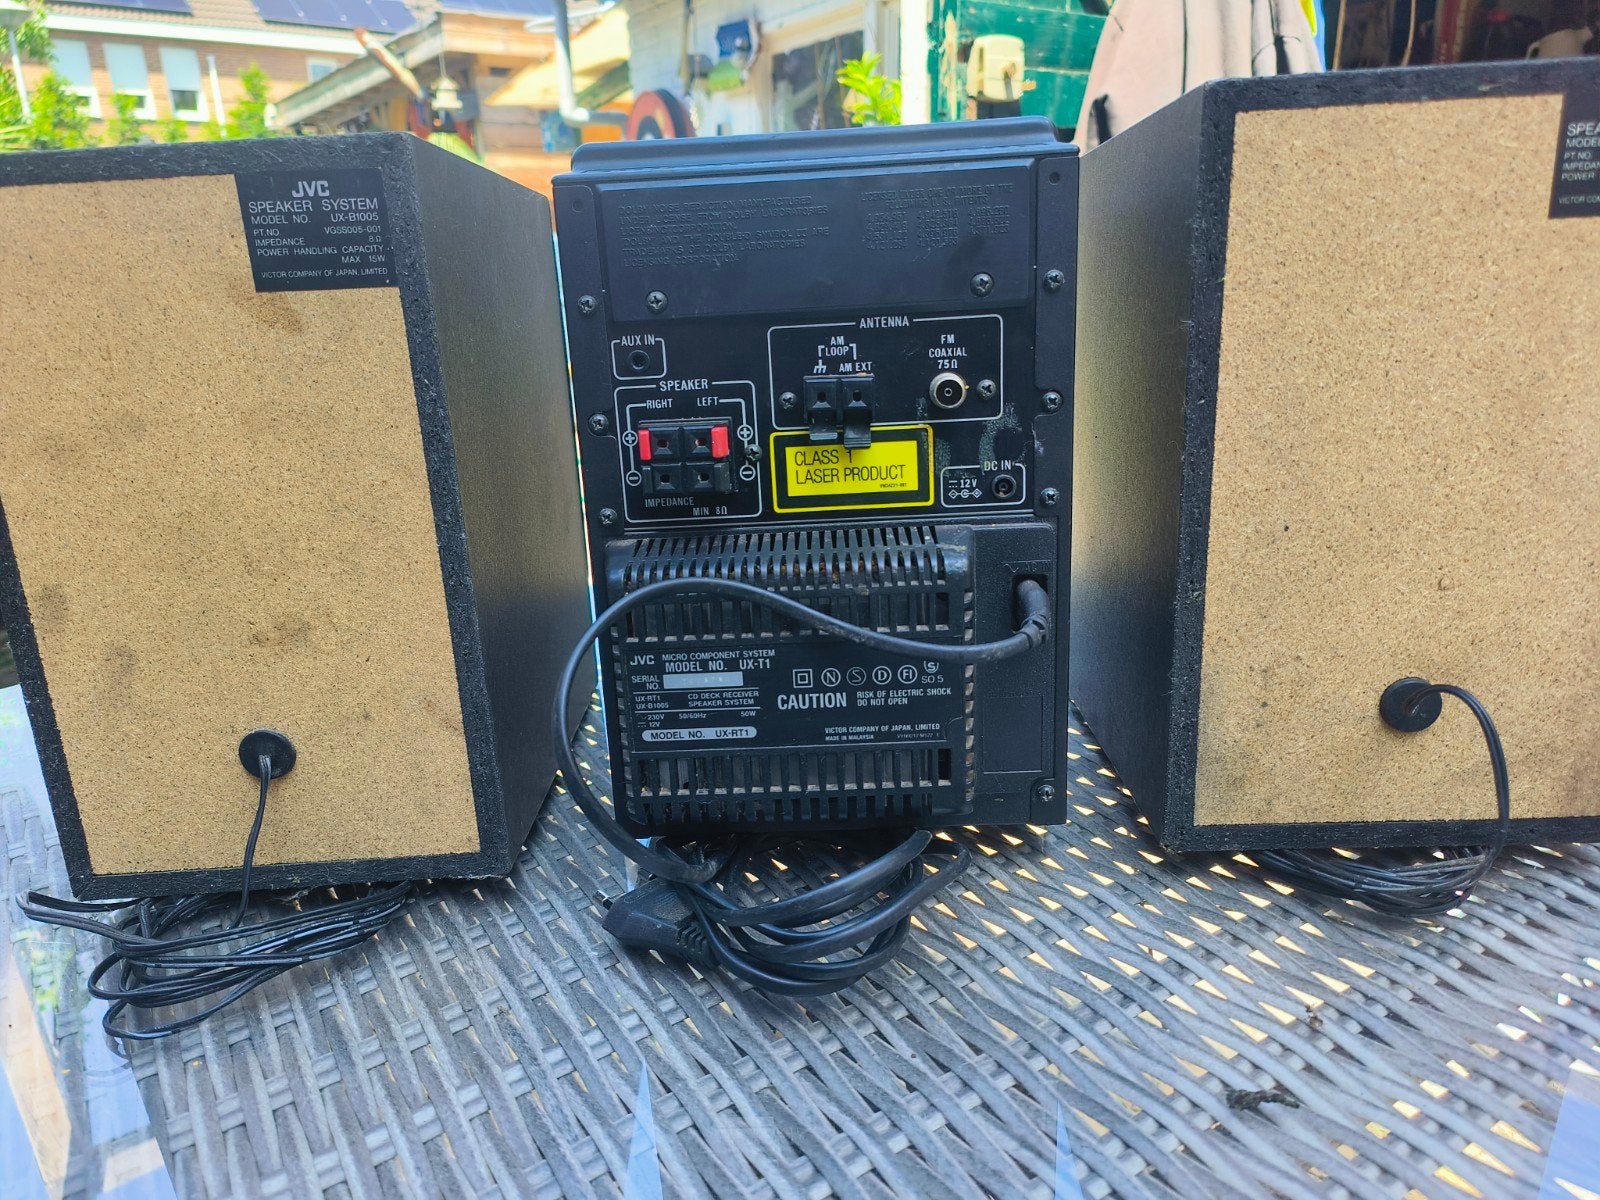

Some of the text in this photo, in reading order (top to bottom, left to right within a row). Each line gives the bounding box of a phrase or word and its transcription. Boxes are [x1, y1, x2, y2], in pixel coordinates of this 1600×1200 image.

[292, 180, 330, 198] JVC
[248, 198, 378, 214] SPEAKER SYSTEM
[251, 212, 379, 225] MODEL NO. UX-B1005
[255, 238, 306, 246] IMPEDANCE
[257, 244, 384, 256] POWER HANDLING CAPACITY
[342, 254, 386, 264] MAX 15W
[288, 270, 322, 278] COMPANY
[324, 269, 334, 277] OF
[361, 268, 388, 276] LIMITED
[859, 316, 910, 329] ANTENNA
[621, 334, 655, 346] AUX IN
[830, 336, 845, 346] AM
[940, 334, 955, 344] FM
[825, 346, 849, 357] LOOP
[928, 347, 968, 358] COAXIAL
[838, 362, 872, 373] AM EXT
[659, 378, 709, 392] SPEAKER
[646, 396, 718, 410] RIGHT LEFT
[794, 450, 840, 466] CLASS
[984, 460, 1012, 472] DC IN
[796, 464, 906, 484] LASER PRODUCT
[960, 478, 978, 488] 12V
[644, 496, 695, 508] IMPEDANCE
[692, 506, 710, 516] MIN
[630, 649, 776, 666] JVC MICRO COMPONENT SYSTEM
[665, 658, 771, 673] MODEL NO. UX-T1
[632, 674, 660, 684] SERIAL
[646, 682, 660, 690] NO.
[635, 694, 661, 702] UX-RT1
[701, 692, 720, 700] DECK
[723, 690, 760, 698] RECEIVER
[856, 688, 952, 698] RISK OF ELECTRIC SHOCK
[636, 702, 670, 710] UX-B1005
[725, 698, 754, 706] SYSTEM
[777, 692, 847, 710] CAUTION
[857, 698, 908, 706] DO NOT OPEN
[650, 729, 750, 740] MODEL NO. UX-RT1
